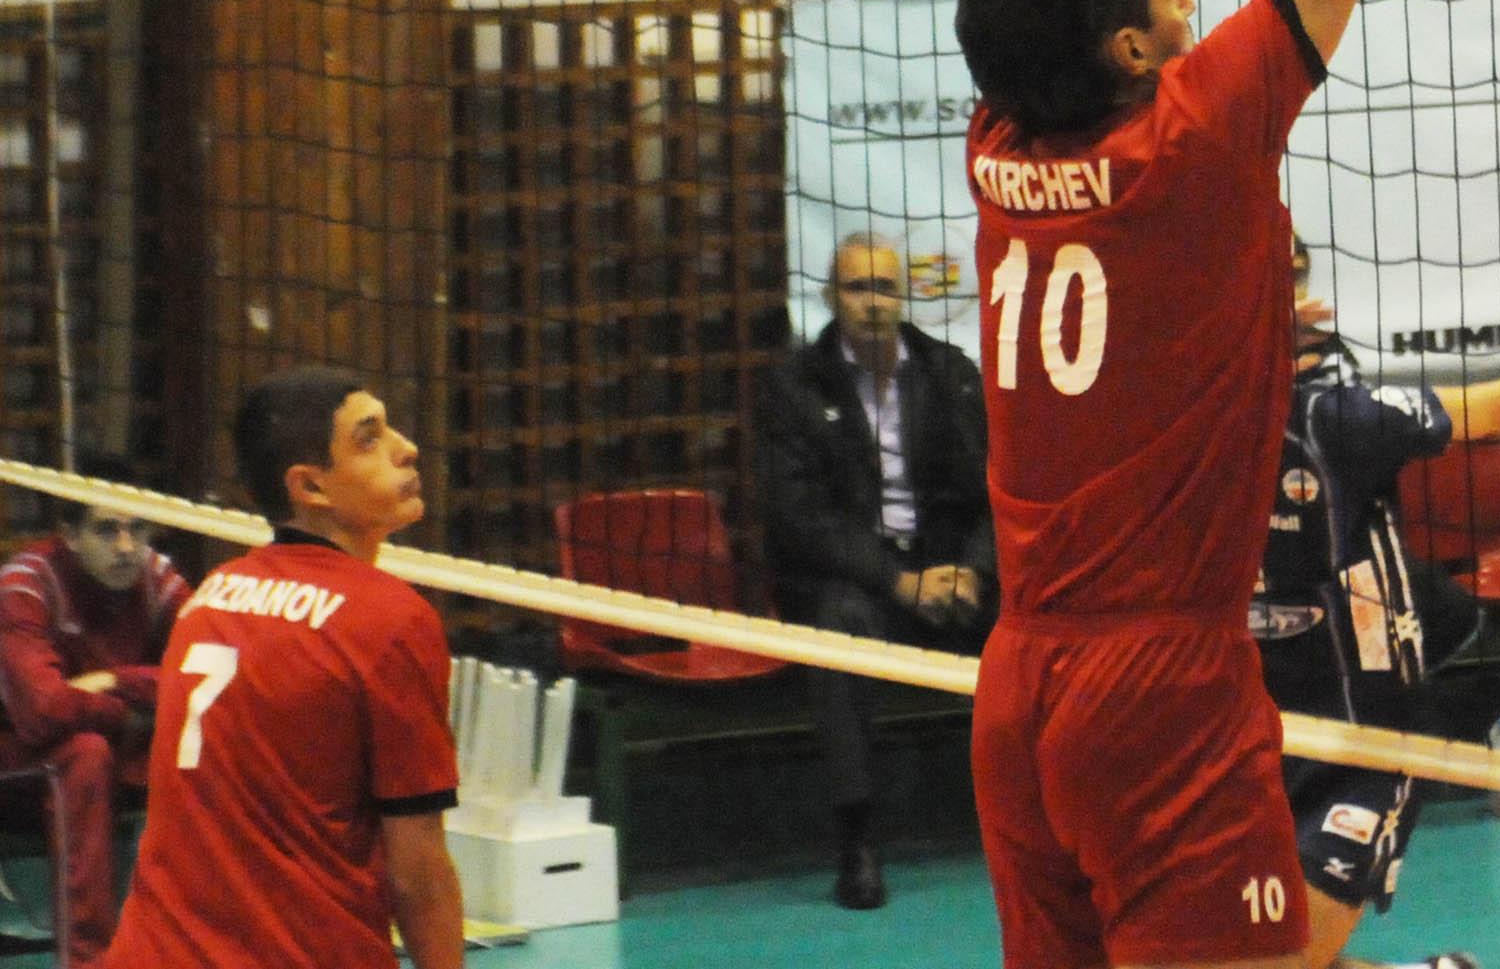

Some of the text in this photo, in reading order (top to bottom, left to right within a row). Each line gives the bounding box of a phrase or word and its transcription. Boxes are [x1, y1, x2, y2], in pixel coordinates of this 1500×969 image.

[990, 237, 1109, 396] 10
[177, 642, 239, 770] 7
[1241, 875, 1286, 924] 10
